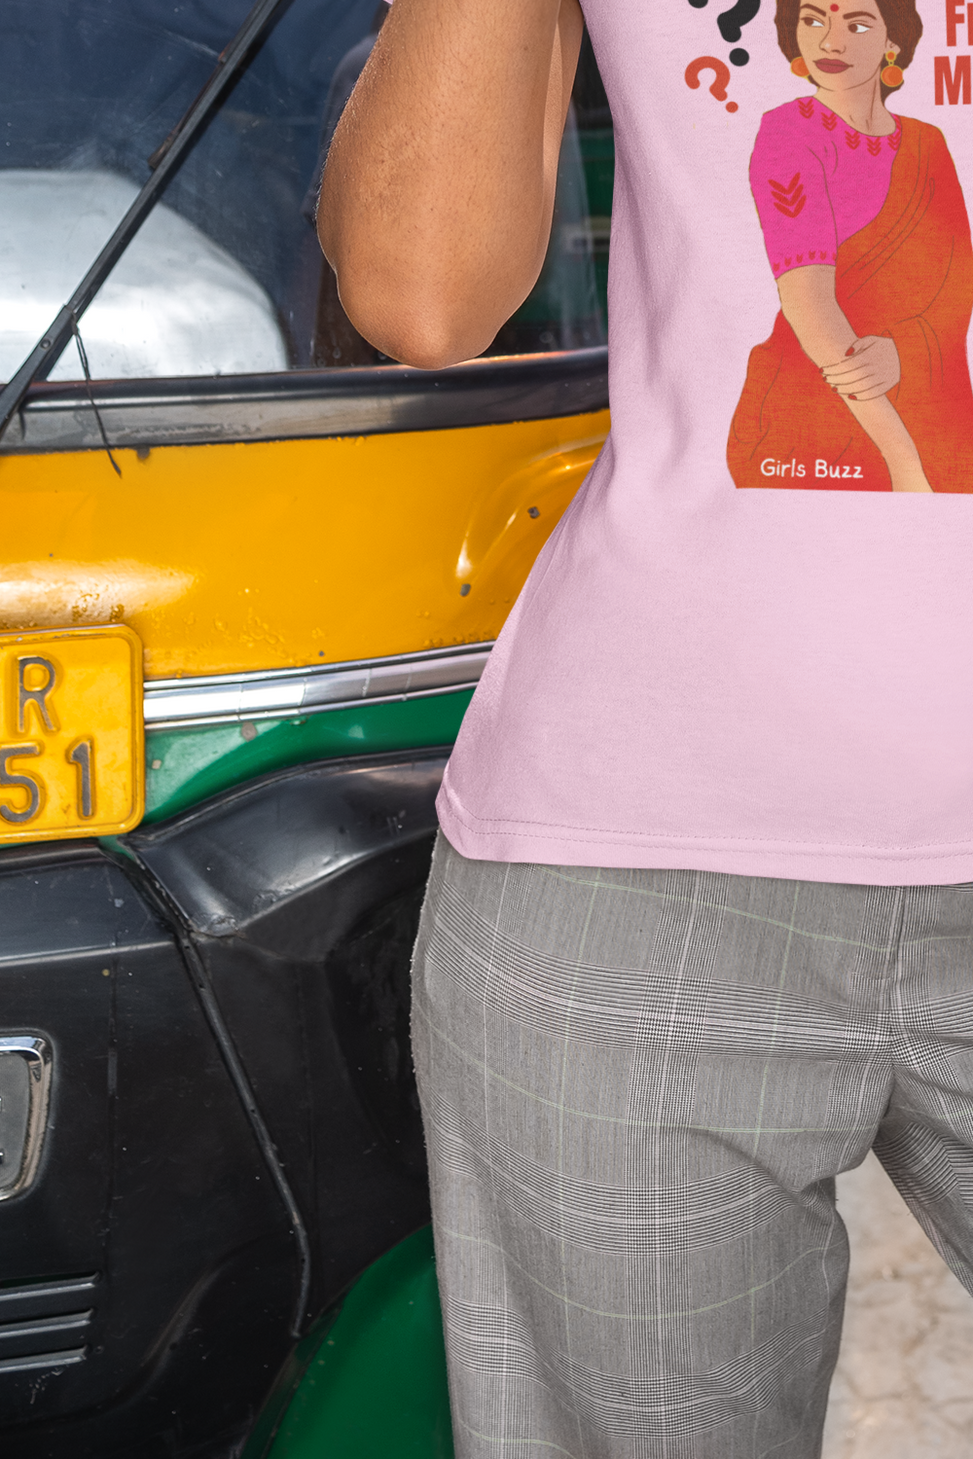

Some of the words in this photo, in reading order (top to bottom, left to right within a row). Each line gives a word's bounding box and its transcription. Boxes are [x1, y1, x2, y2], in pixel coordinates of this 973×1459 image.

[684, 55, 739, 114] ?
[760, 457, 806, 478] Girls
[814, 458, 864, 479] Buzz
[17, 655, 57, 732] R
